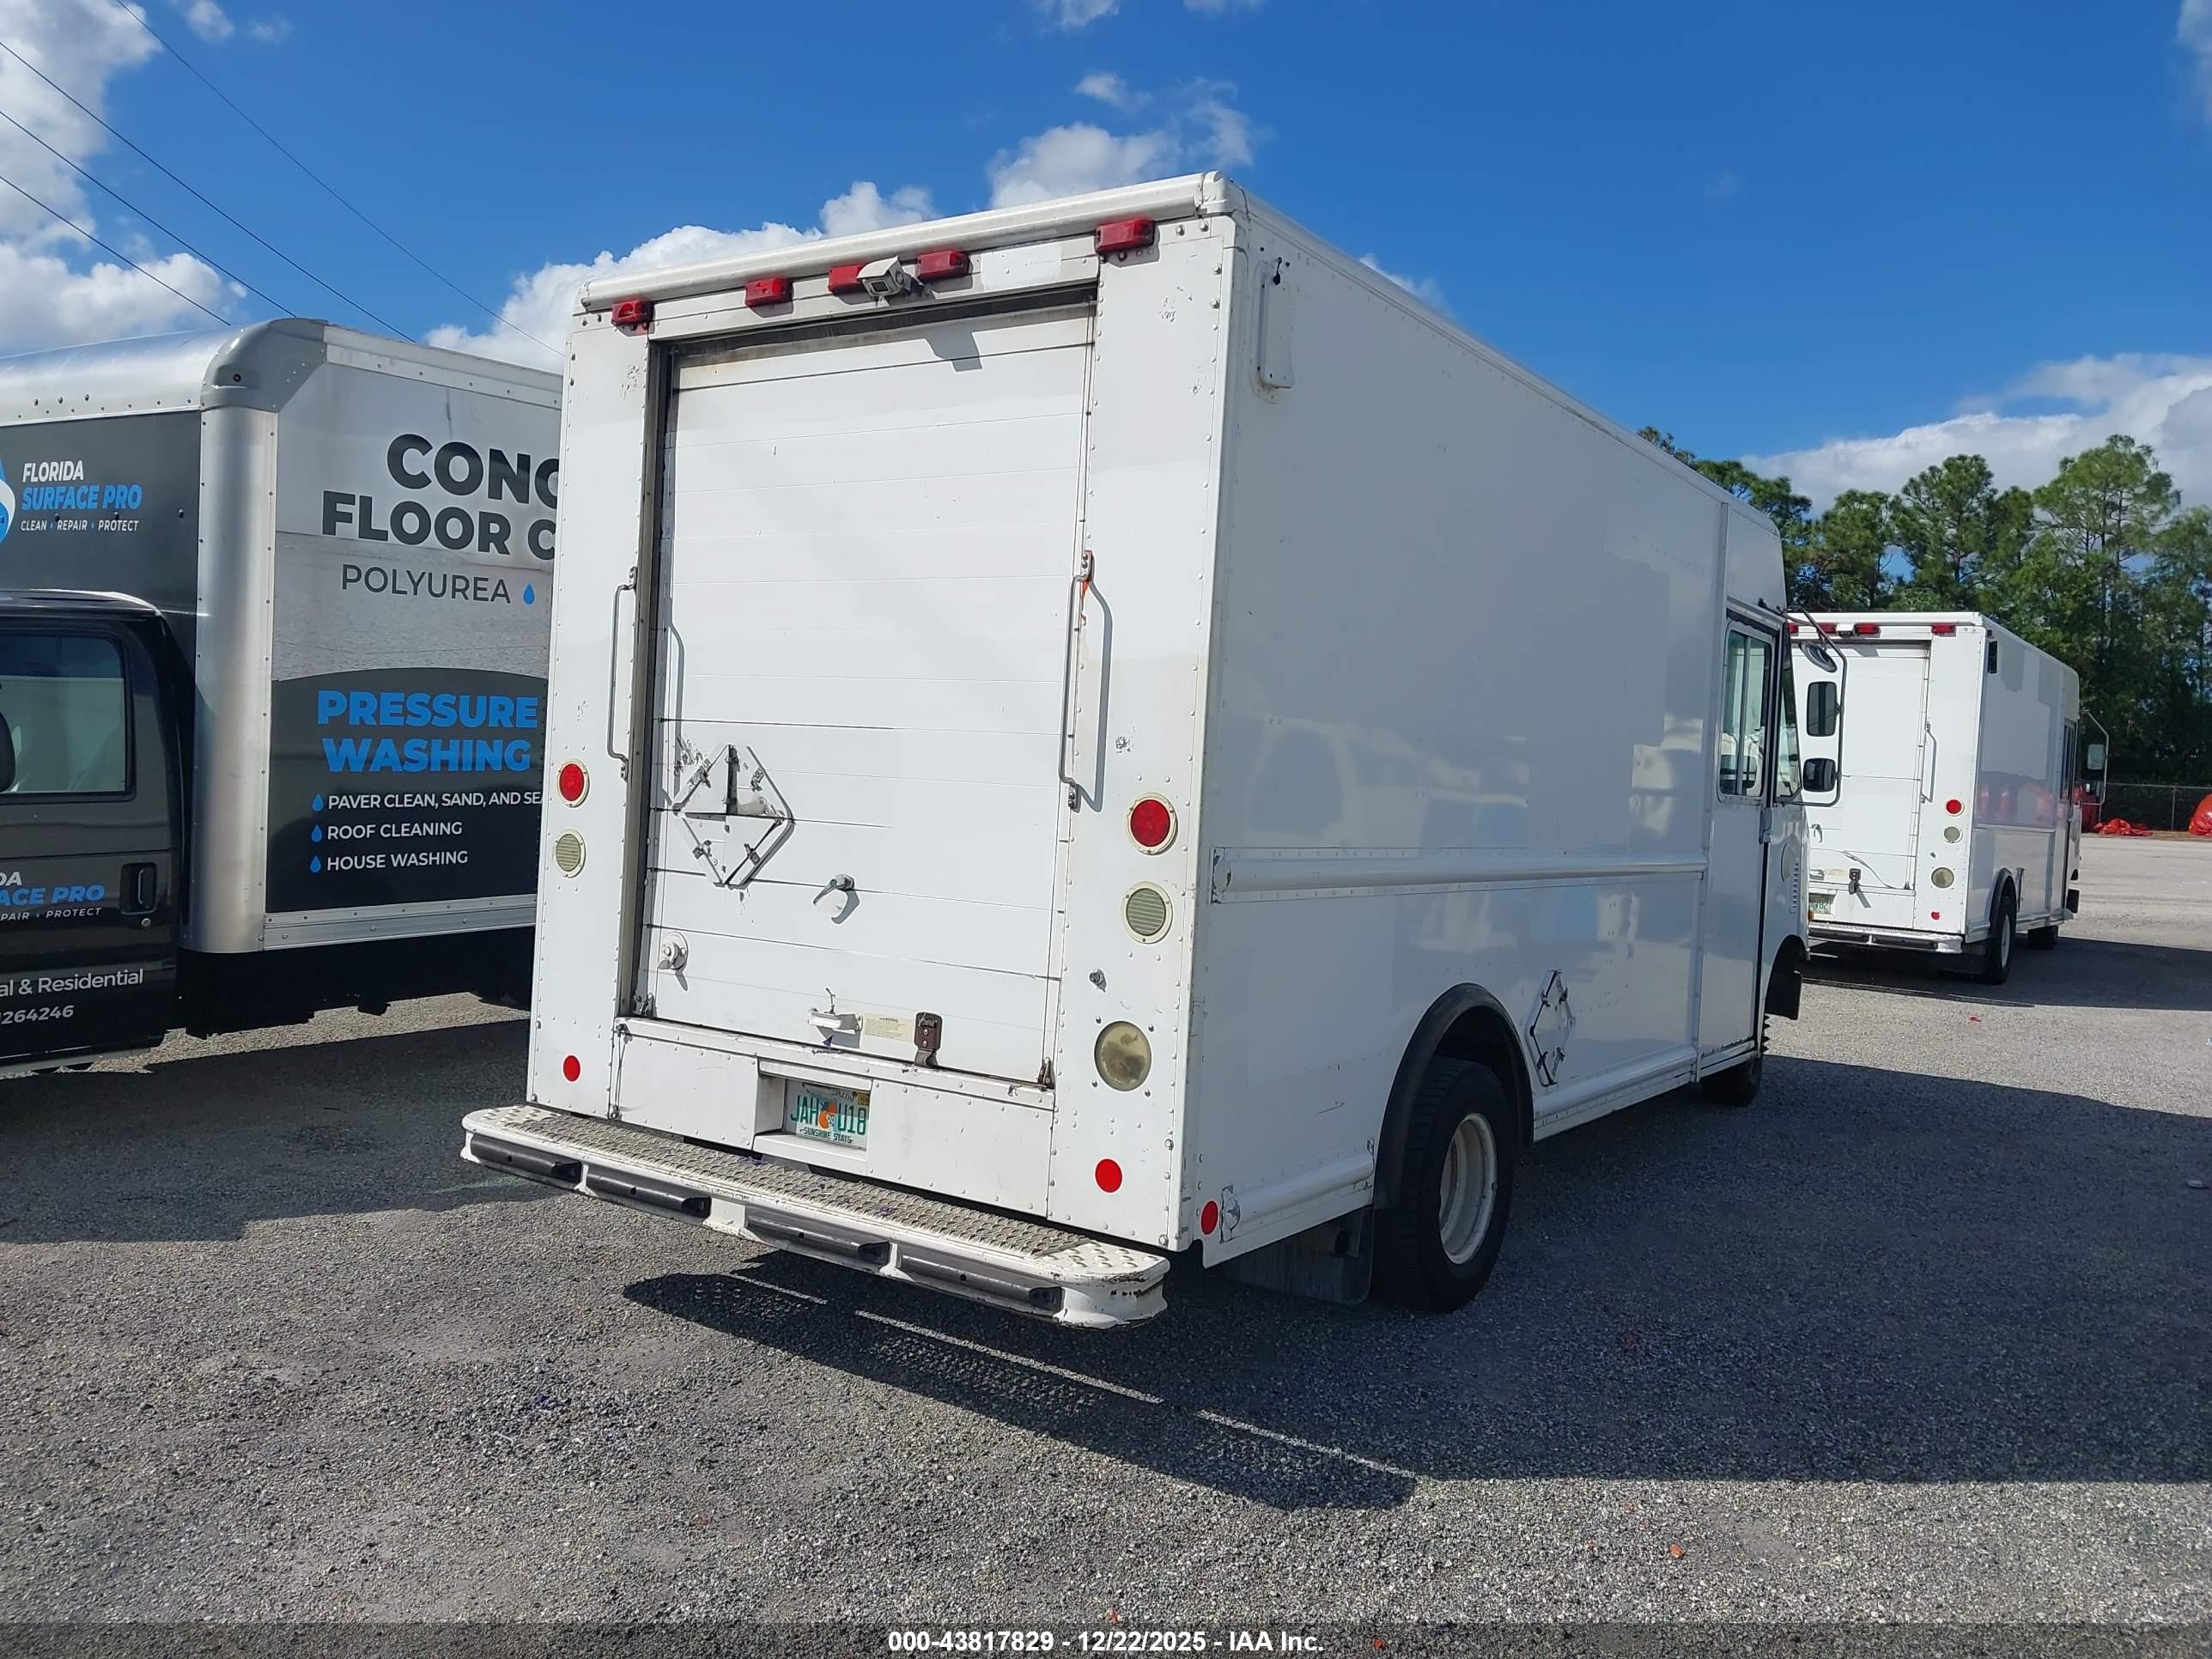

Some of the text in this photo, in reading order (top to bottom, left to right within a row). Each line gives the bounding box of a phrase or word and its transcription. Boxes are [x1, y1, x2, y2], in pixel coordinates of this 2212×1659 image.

[22, 460, 84, 483] FLORIDA
[21, 485, 142, 510] SURFACE PRO
[21, 520, 139, 532] CLEAN REPAIR PROTECT
[322, 490, 512, 555] FLOOR
[342, 563, 512, 604] POLYUREA
[317, 690, 538, 729] PRESSURE
[322, 738, 532, 772] WASHING
[328, 791, 543, 810] PAVER CLEAN, SAND, AND SE
[327, 822, 463, 840] ROOF CLEANING
[327, 851, 468, 871] HOUSE WASHING
[52, 884, 106, 903] PRO
[46, 908, 101, 918] PROTECT
[18, 979, 33, 994] &
[38, 969, 143, 994] Residential
[0, 1005, 75, 1024] 264246
